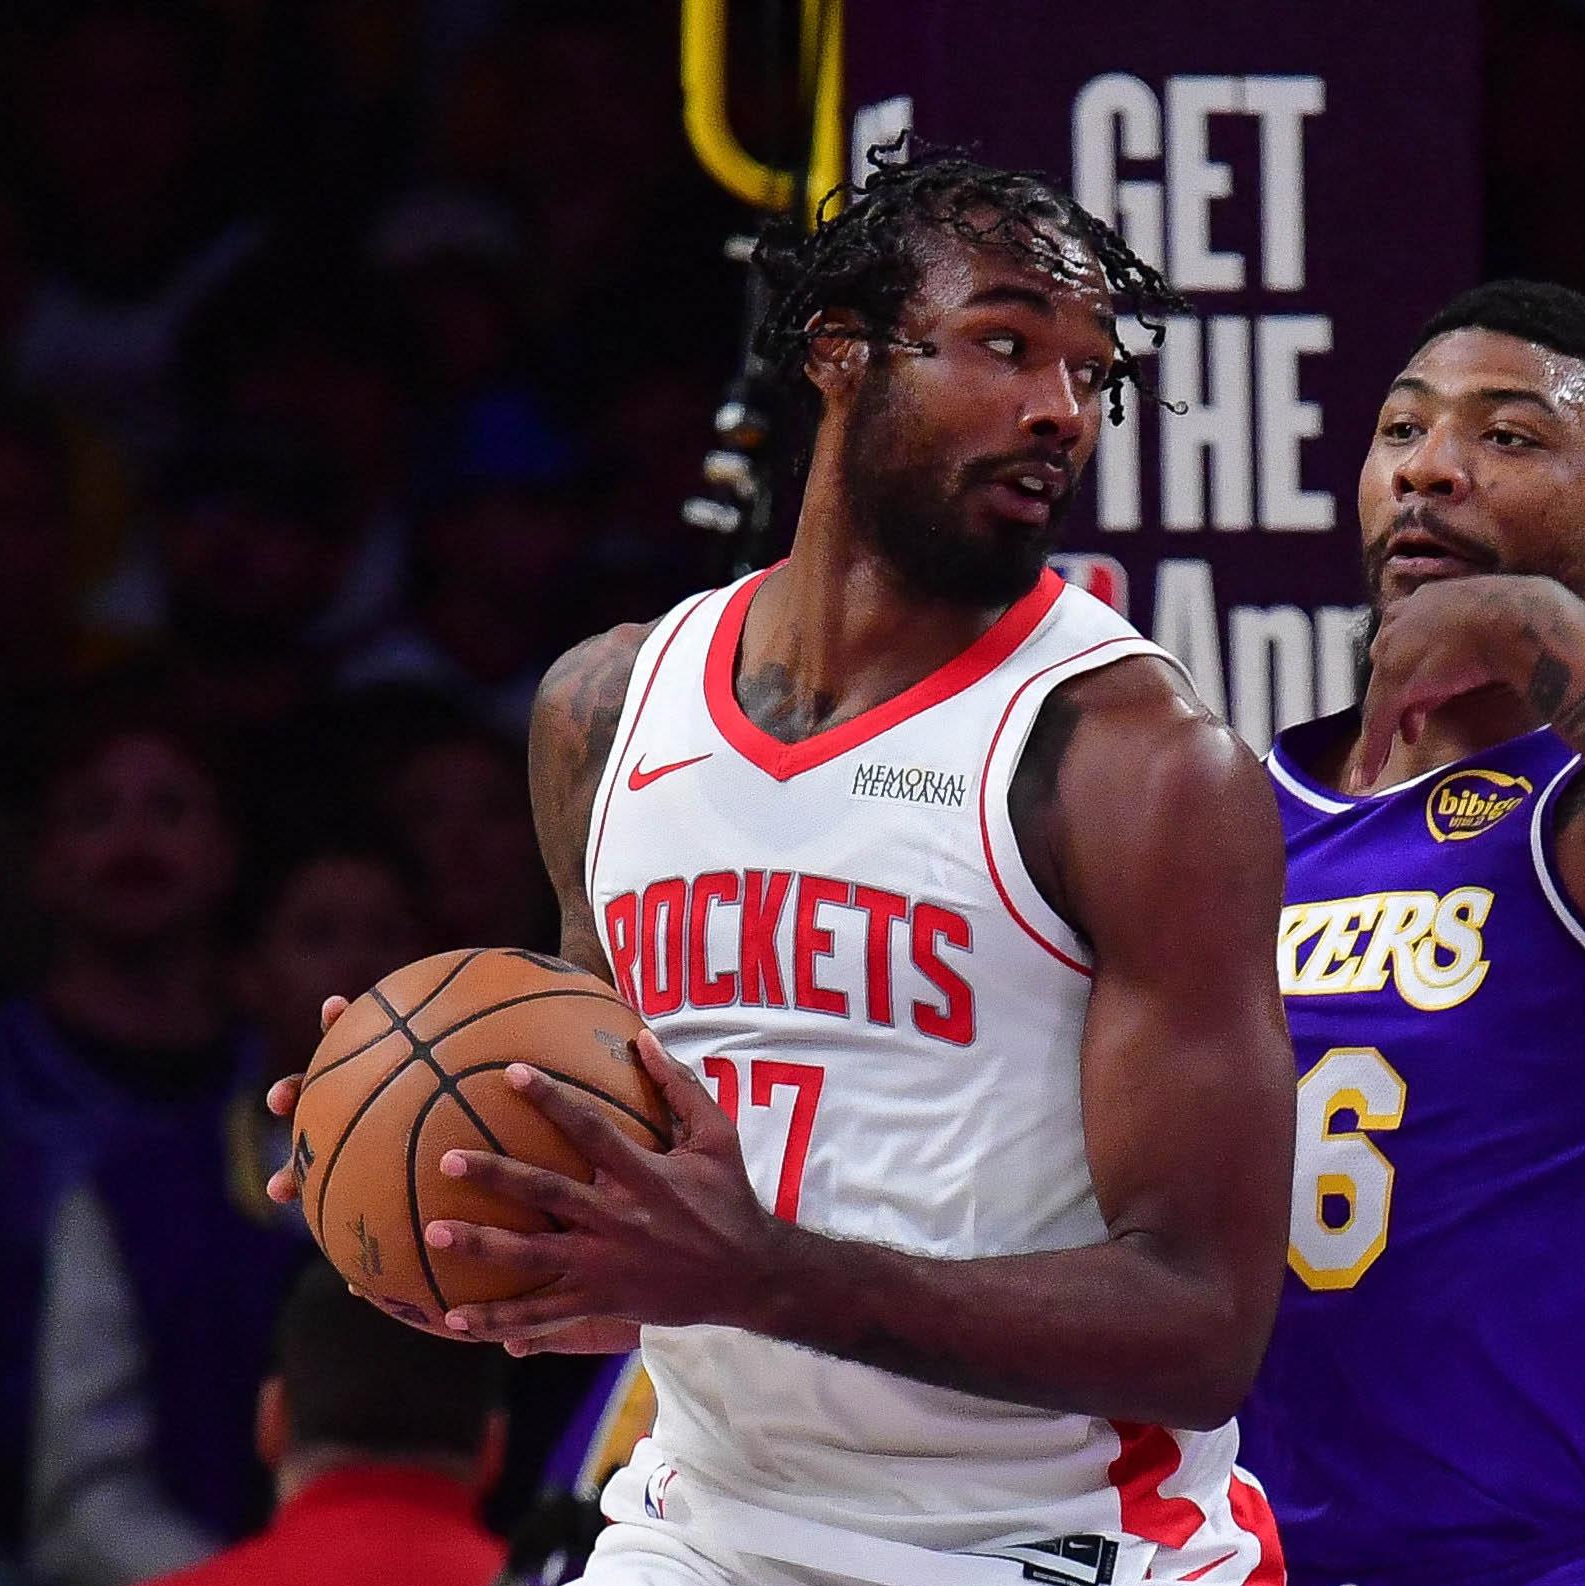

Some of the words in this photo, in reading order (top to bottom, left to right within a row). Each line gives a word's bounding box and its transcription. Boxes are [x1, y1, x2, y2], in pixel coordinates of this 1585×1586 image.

[1070, 71, 1328, 294] GET
[1097, 312, 1337, 533] THE
[851, 778, 964, 807] HERMANN
[854, 763, 966, 793] MEMORIAL
[1437, 788, 1524, 822] bibigo
[604, 866, 977, 1047] ROCKETS
[1286, 1046, 1408, 1292] 6
